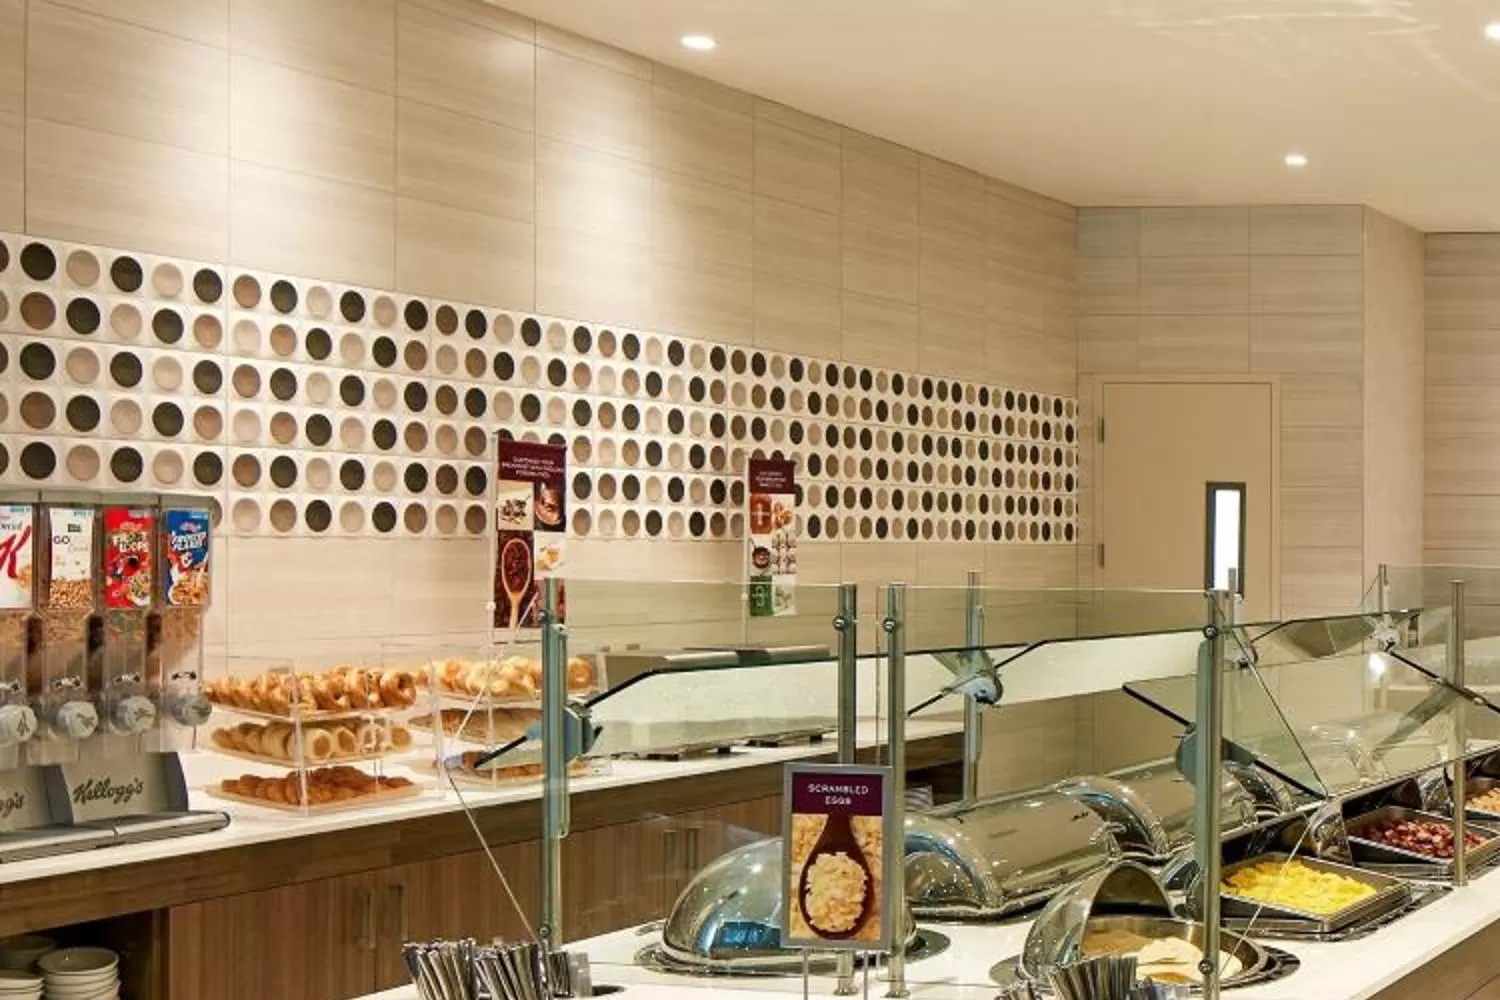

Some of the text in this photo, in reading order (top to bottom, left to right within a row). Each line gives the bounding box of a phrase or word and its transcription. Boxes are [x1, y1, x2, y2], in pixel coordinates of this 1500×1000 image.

[72, 777, 144, 804] Kellogg's
[807, 783, 870, 795] SCRAMBLED
[825, 795, 852, 805] EGGS
